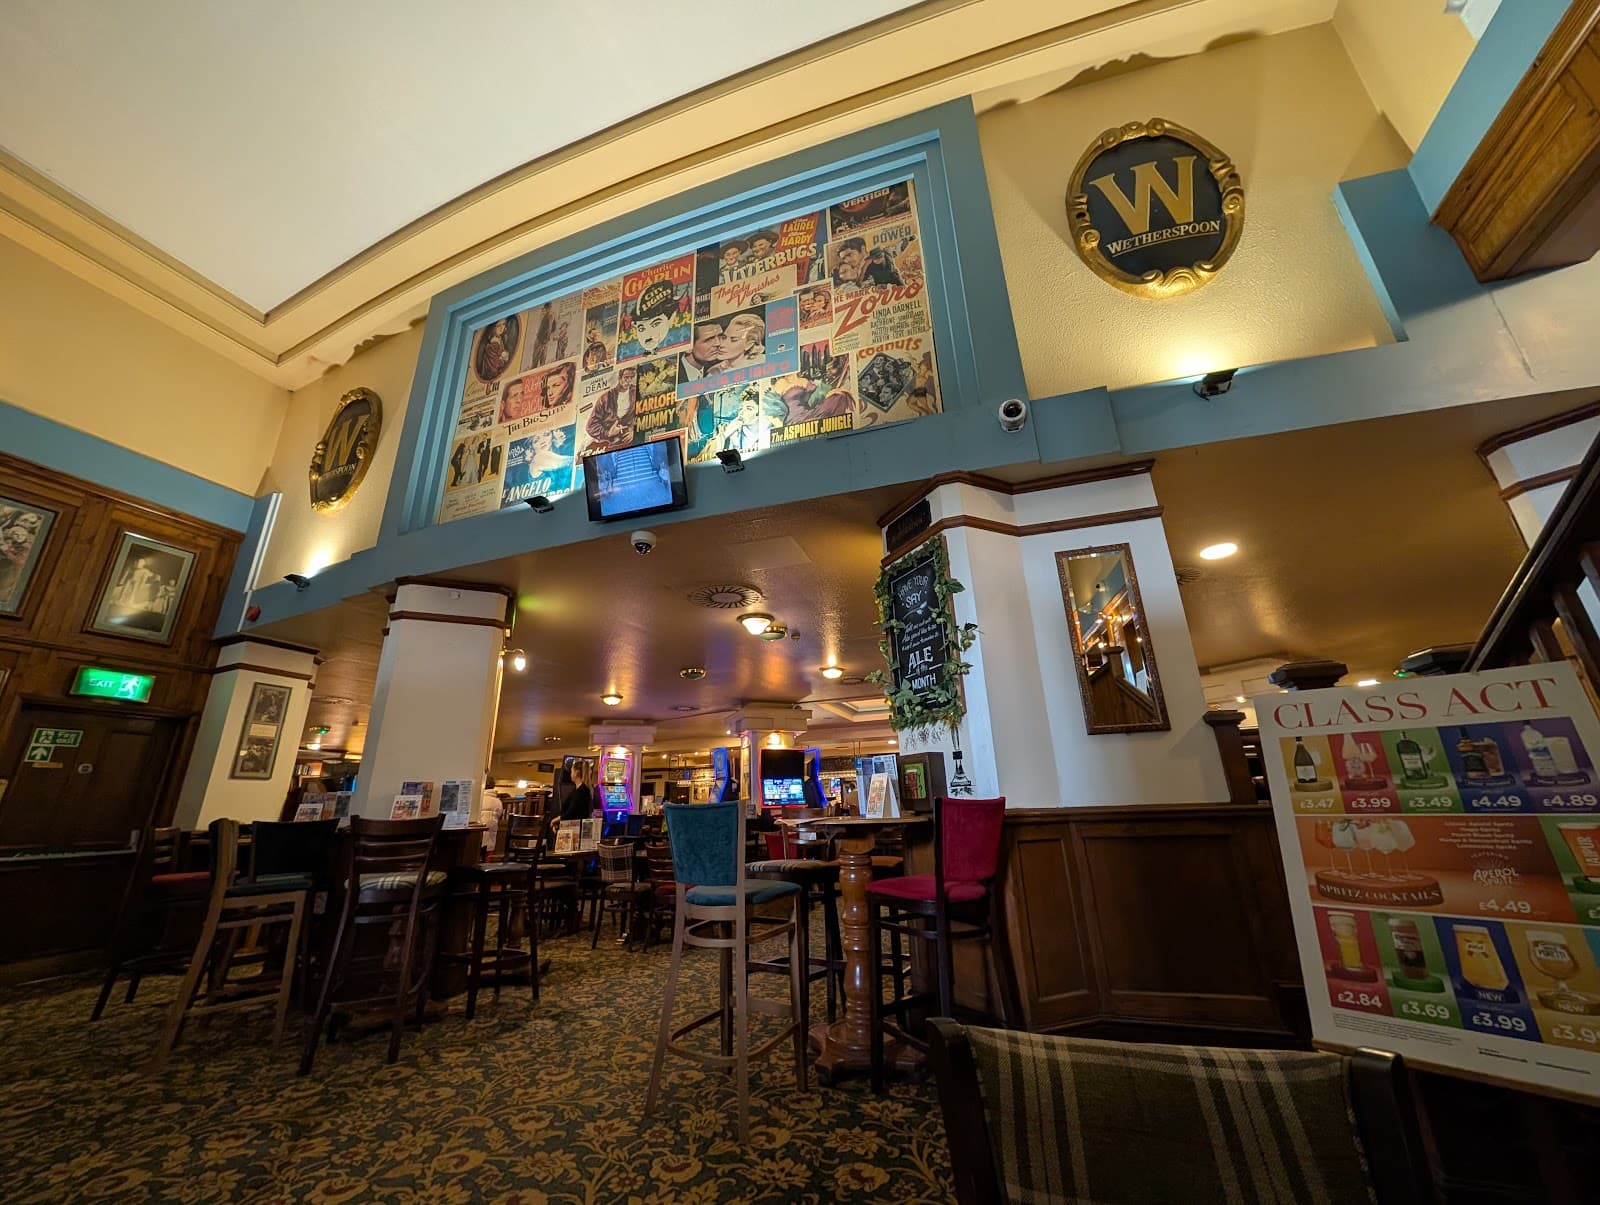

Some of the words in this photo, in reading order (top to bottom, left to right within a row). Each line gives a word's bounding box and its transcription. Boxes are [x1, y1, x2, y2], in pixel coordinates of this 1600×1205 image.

[842, 187, 890, 208] VERTIGO
[1089, 155, 1198, 236] W
[783, 220, 815, 233] LAUREL
[873, 226, 912, 245] POWER
[781, 234, 813, 247] HARDY
[1106, 220, 1221, 255] WETHERSPOON
[624, 264, 692, 297] CHAPLIN
[641, 289, 672, 311] LIGHTS
[645, 285, 664, 300] CITY
[835, 282, 923, 339] Zorro
[872, 307, 891, 319] LINDA
[892, 300, 921, 313] DARNELL
[585, 380, 608, 394] DEAN
[635, 391, 676, 415] KARLOFF
[504, 422, 522, 436] THE
[522, 415, 539, 429] BIG
[539, 405, 567, 423] SLEEP
[636, 408, 676, 432] MUMMY
[771, 431, 784, 443] The
[783, 420, 819, 440] ASPHALT
[820, 413, 853, 433] JUNGLE
[898, 579, 912, 601] HAVE
[913, 575, 929, 588] YOUR
[905, 590, 922, 608] SAY
[908, 646, 934, 674] ALE
[88, 678, 115, 689] EXIT
[911, 673, 937, 691] MONTH
[1273, 692, 1427, 730] CLASS
[1443, 677, 1557, 717] ACT
[1300, 798, 1335, 809] £3.47
[1351, 797, 1391, 809] £3.99
[1409, 796, 1453, 808] £3.49
[1471, 795, 1522, 808] £4.49
[1543, 794, 1598, 807] £4.89
[1473, 867, 1520, 882] APEROL
[1319, 883, 1363, 899] SPRITZ
[1365, 890, 1440, 902] COCKTAILS
[1479, 900, 1532, 914] £4.49
[1338, 990, 1382, 1009] £2.84
[1402, 1001, 1450, 1020] £3.69
[1472, 1012, 1527, 1032] £3.99
